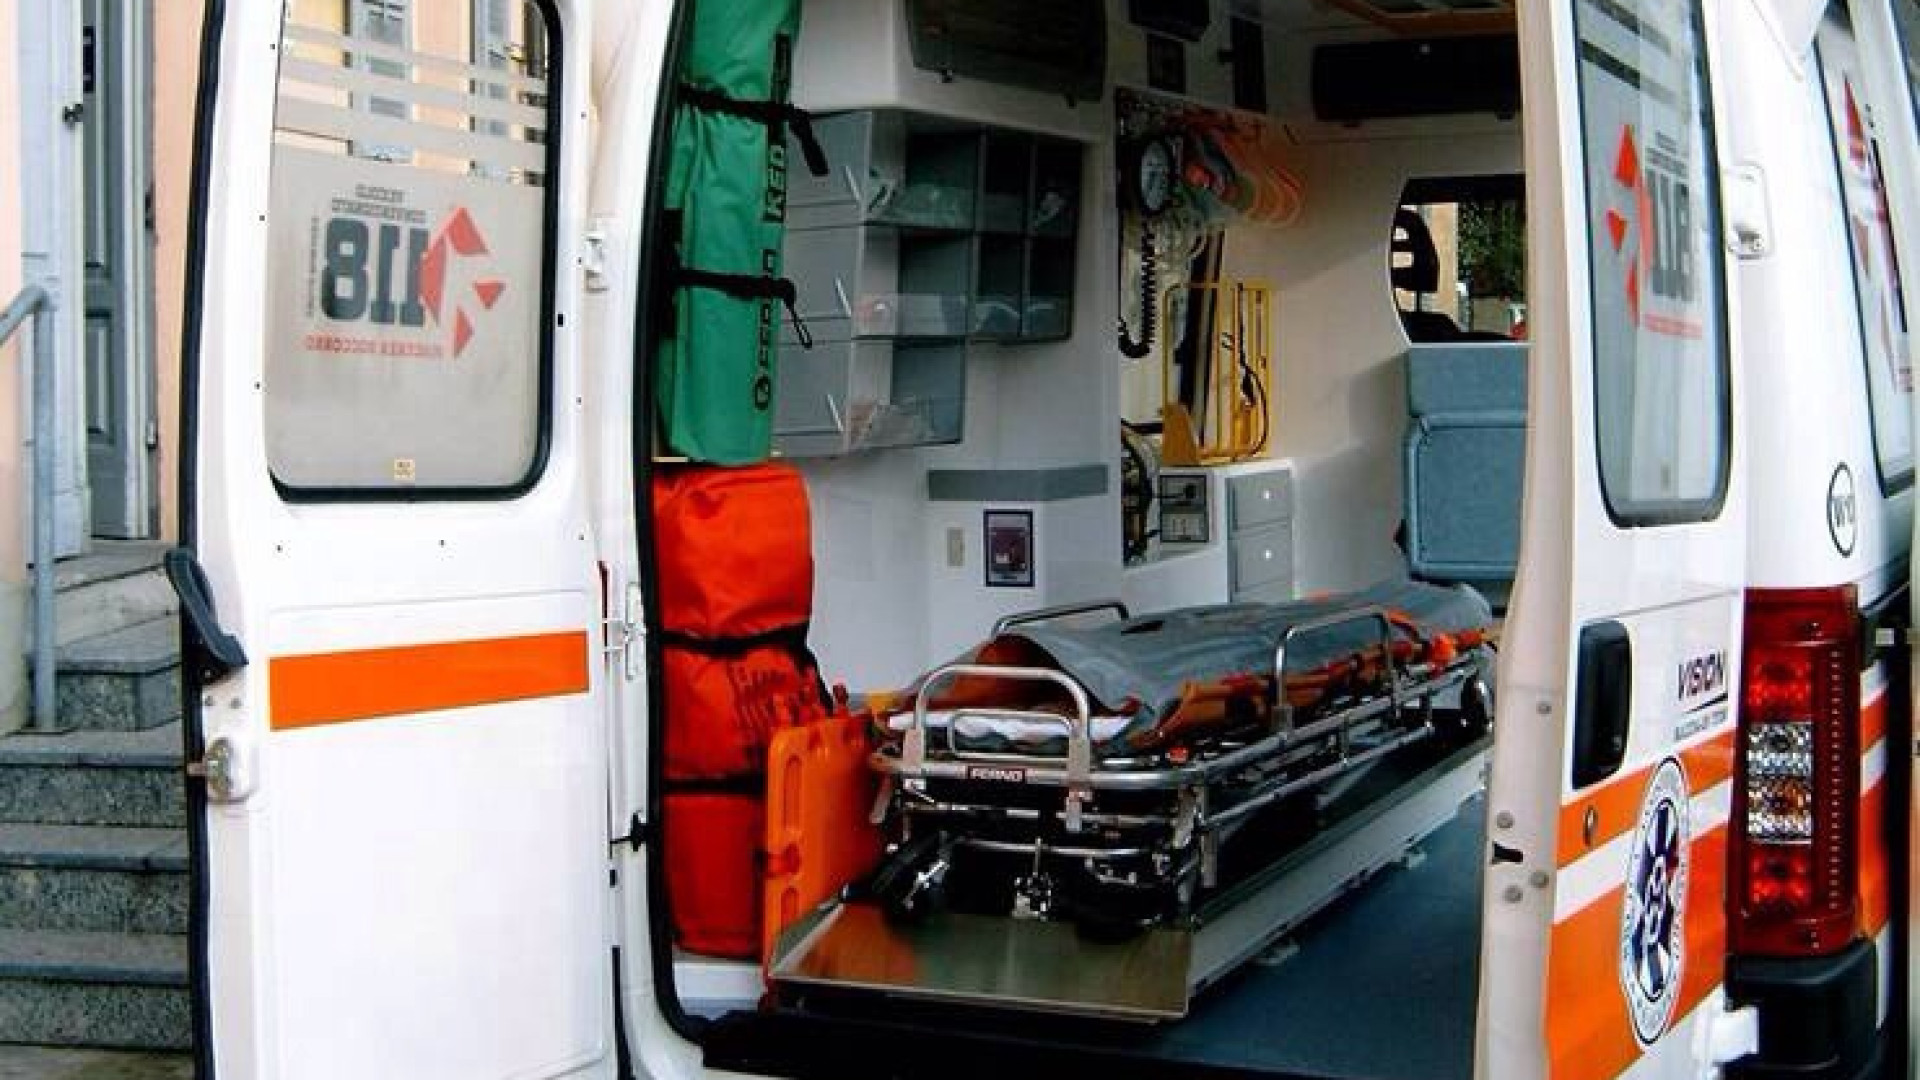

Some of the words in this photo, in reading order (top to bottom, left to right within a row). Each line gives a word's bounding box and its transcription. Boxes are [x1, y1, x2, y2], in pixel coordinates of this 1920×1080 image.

[764, 145, 785, 220] KED
[1645, 168, 1694, 301] 118
[1678, 649, 1729, 702] VISION
[970, 767, 1023, 782] FERNO
